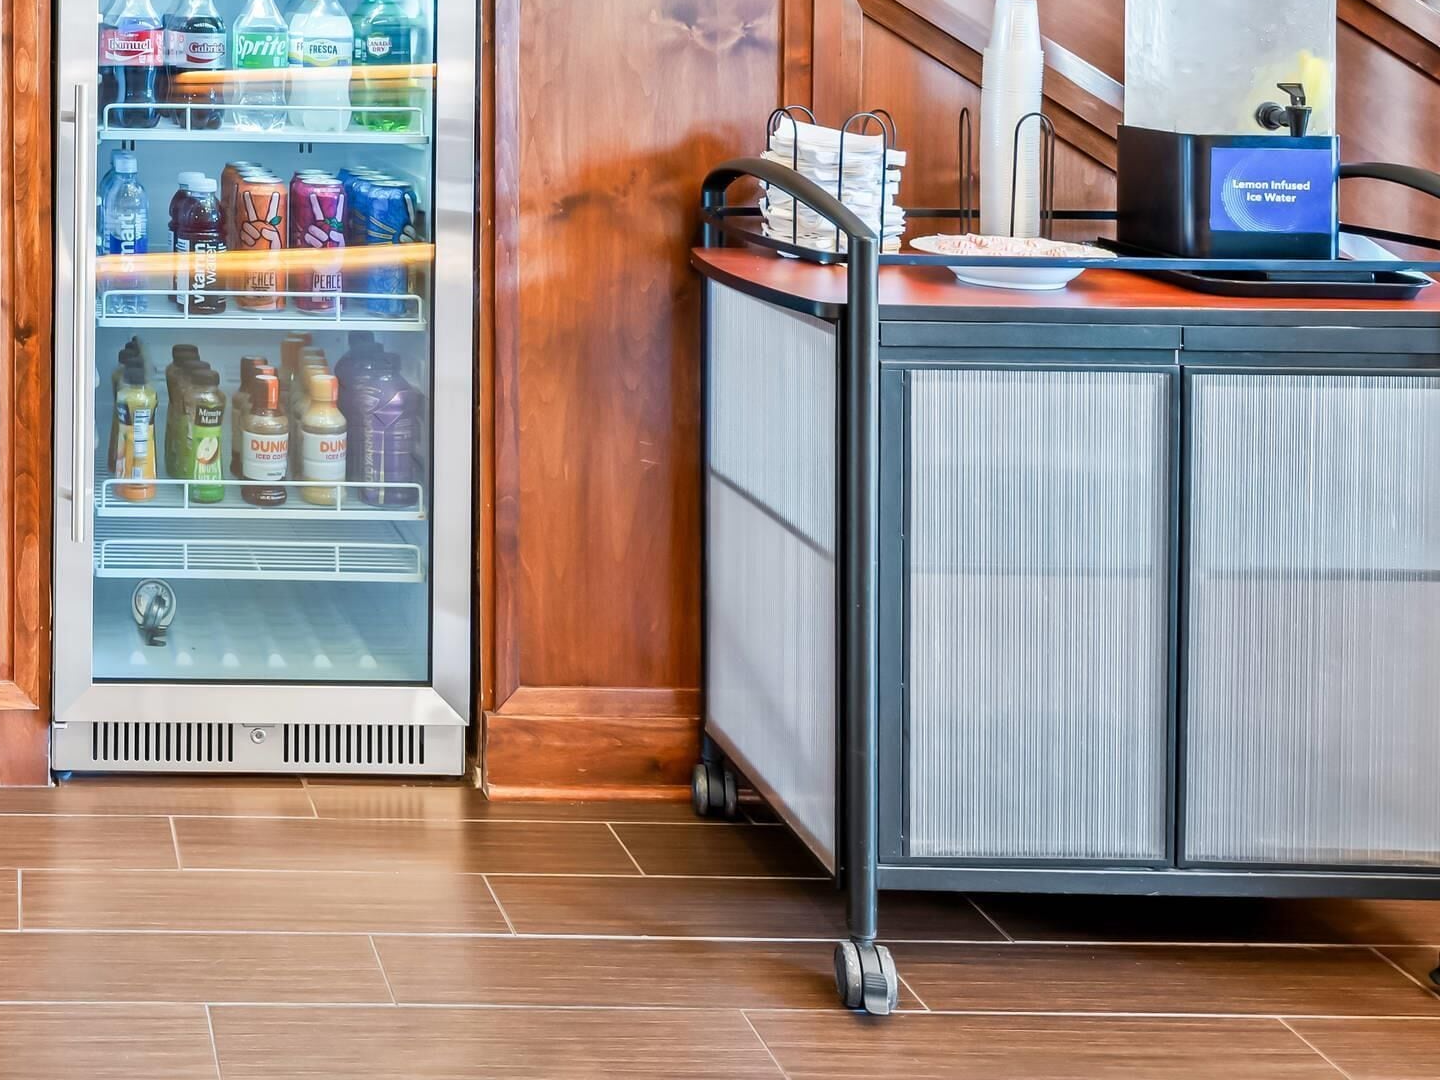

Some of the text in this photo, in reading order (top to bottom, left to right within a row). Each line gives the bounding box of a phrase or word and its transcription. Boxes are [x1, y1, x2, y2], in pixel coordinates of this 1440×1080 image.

[188, 42, 225, 53] Gabriel
[238, 35, 286, 60] Sprite
[309, 45, 338, 55] FRESCA
[1233, 180, 1310, 191] Lemon Infused
[1247, 192, 1297, 203] Ice Water
[206, 244, 217, 284] water
[314, 274, 341, 289] PEACE
[198, 408, 221, 417] Minute
[201, 416, 218, 424] Maid
[320, 440, 346, 453] DUN
